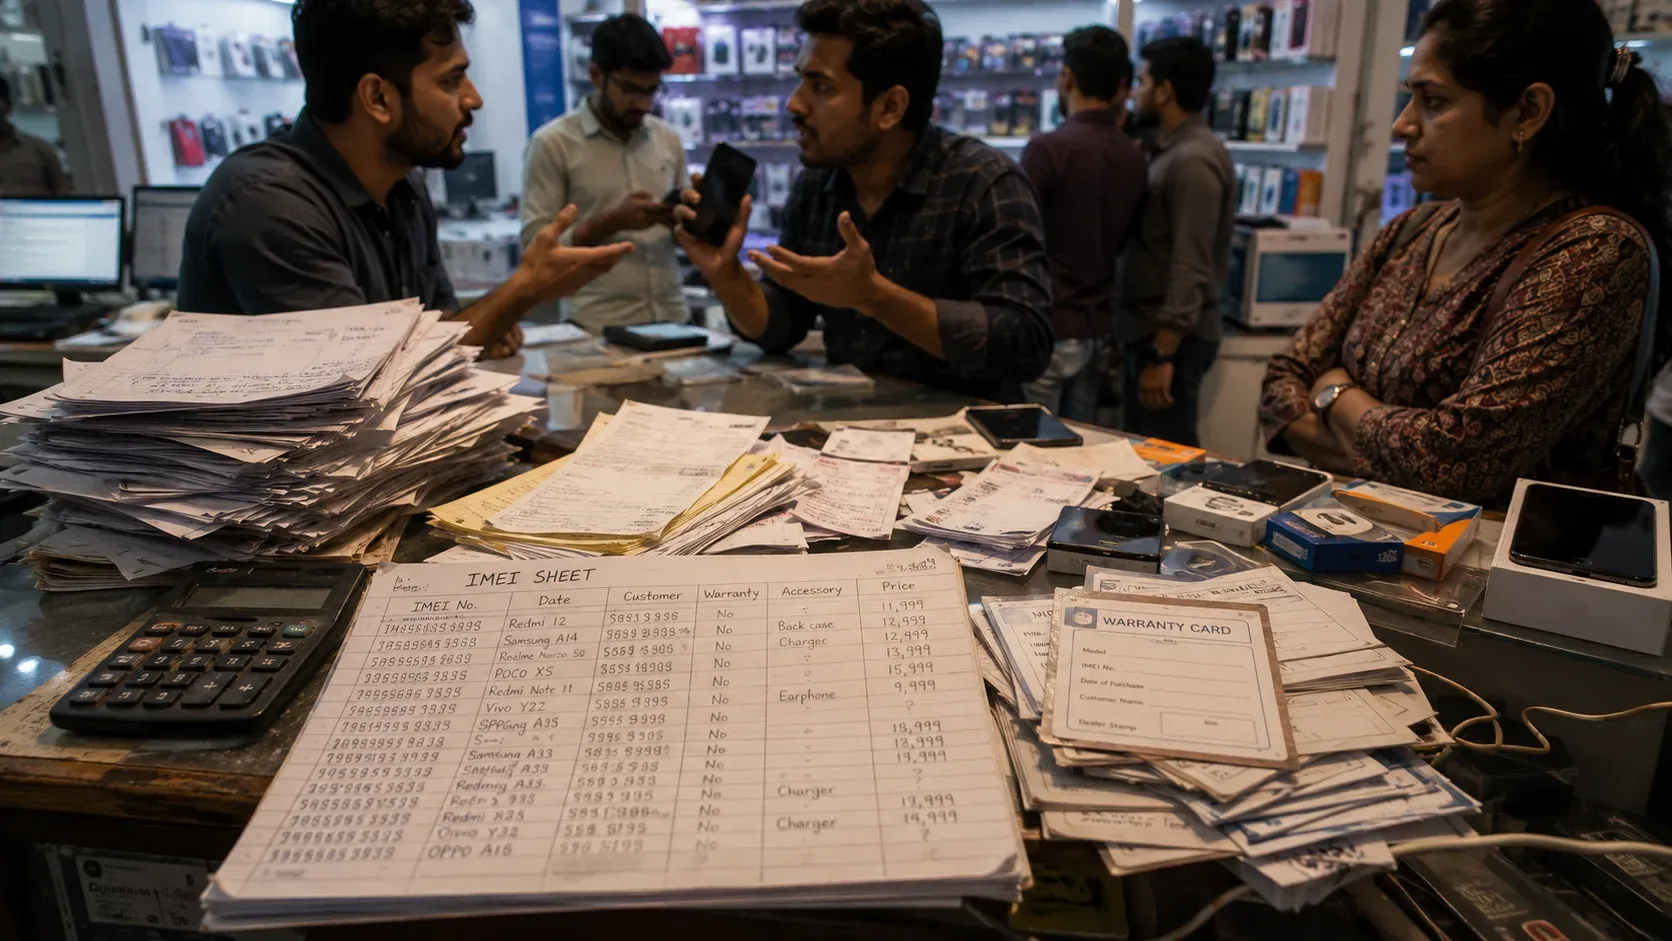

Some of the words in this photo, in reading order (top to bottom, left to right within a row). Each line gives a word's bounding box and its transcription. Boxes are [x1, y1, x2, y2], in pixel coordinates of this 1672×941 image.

[465, 571, 521, 587] IMEI
[533, 568, 596, 584] SHEET
[781, 586, 842, 597] Accessory
[882, 580, 916, 591] Price
[538, 594, 571, 606] Date
[623, 590, 683, 601] Customer
[704, 588, 760, 601] Warranty
[411, 600, 450, 612] IMEI
[456, 600, 477, 610] No.
[881, 599, 924, 613] 11,999
[717, 609, 733, 619] No
[509, 616, 545, 629] Redmi
[553, 616, 567, 627] 12
[778, 620, 804, 632] Back
[882, 615, 926, 628] 12,999
[1103, 616, 1184, 631] WARRANTY
[1190, 623, 1231, 635] CARD
[716, 625, 733, 634] No
[504, 633, 550, 650] Samsung
[555, 632, 577, 643] A14
[715, 641, 732, 652] No
[886, 644, 931, 660] 13,999
[1082, 647, 1107, 655] Model
[713, 658, 730, 668] No
[888, 661, 934, 677] 15,999
[495, 667, 528, 679] POCO
[712, 676, 730, 687] No
[1080, 677, 1098, 685] Date
[488, 684, 524, 697] Redmi
[530, 684, 556, 695] Note
[562, 684, 573, 693] 11
[893, 680, 936, 695] 9,999
[711, 694, 729, 705] No
[779, 689, 837, 705] Earphone
[486, 702, 512, 713] Vivo
[520, 701, 545, 712] Y22
[710, 712, 728, 723] No
[708, 729, 727, 739] No
[706, 744, 726, 755] No
[704, 760, 724, 769] No
[702, 774, 722, 784] No
[701, 788, 722, 800] No
[777, 785, 835, 800] Charger
[699, 804, 721, 816] No
[697, 820, 720, 832] No
[776, 817, 838, 835] Charger
[696, 838, 718, 850] No
